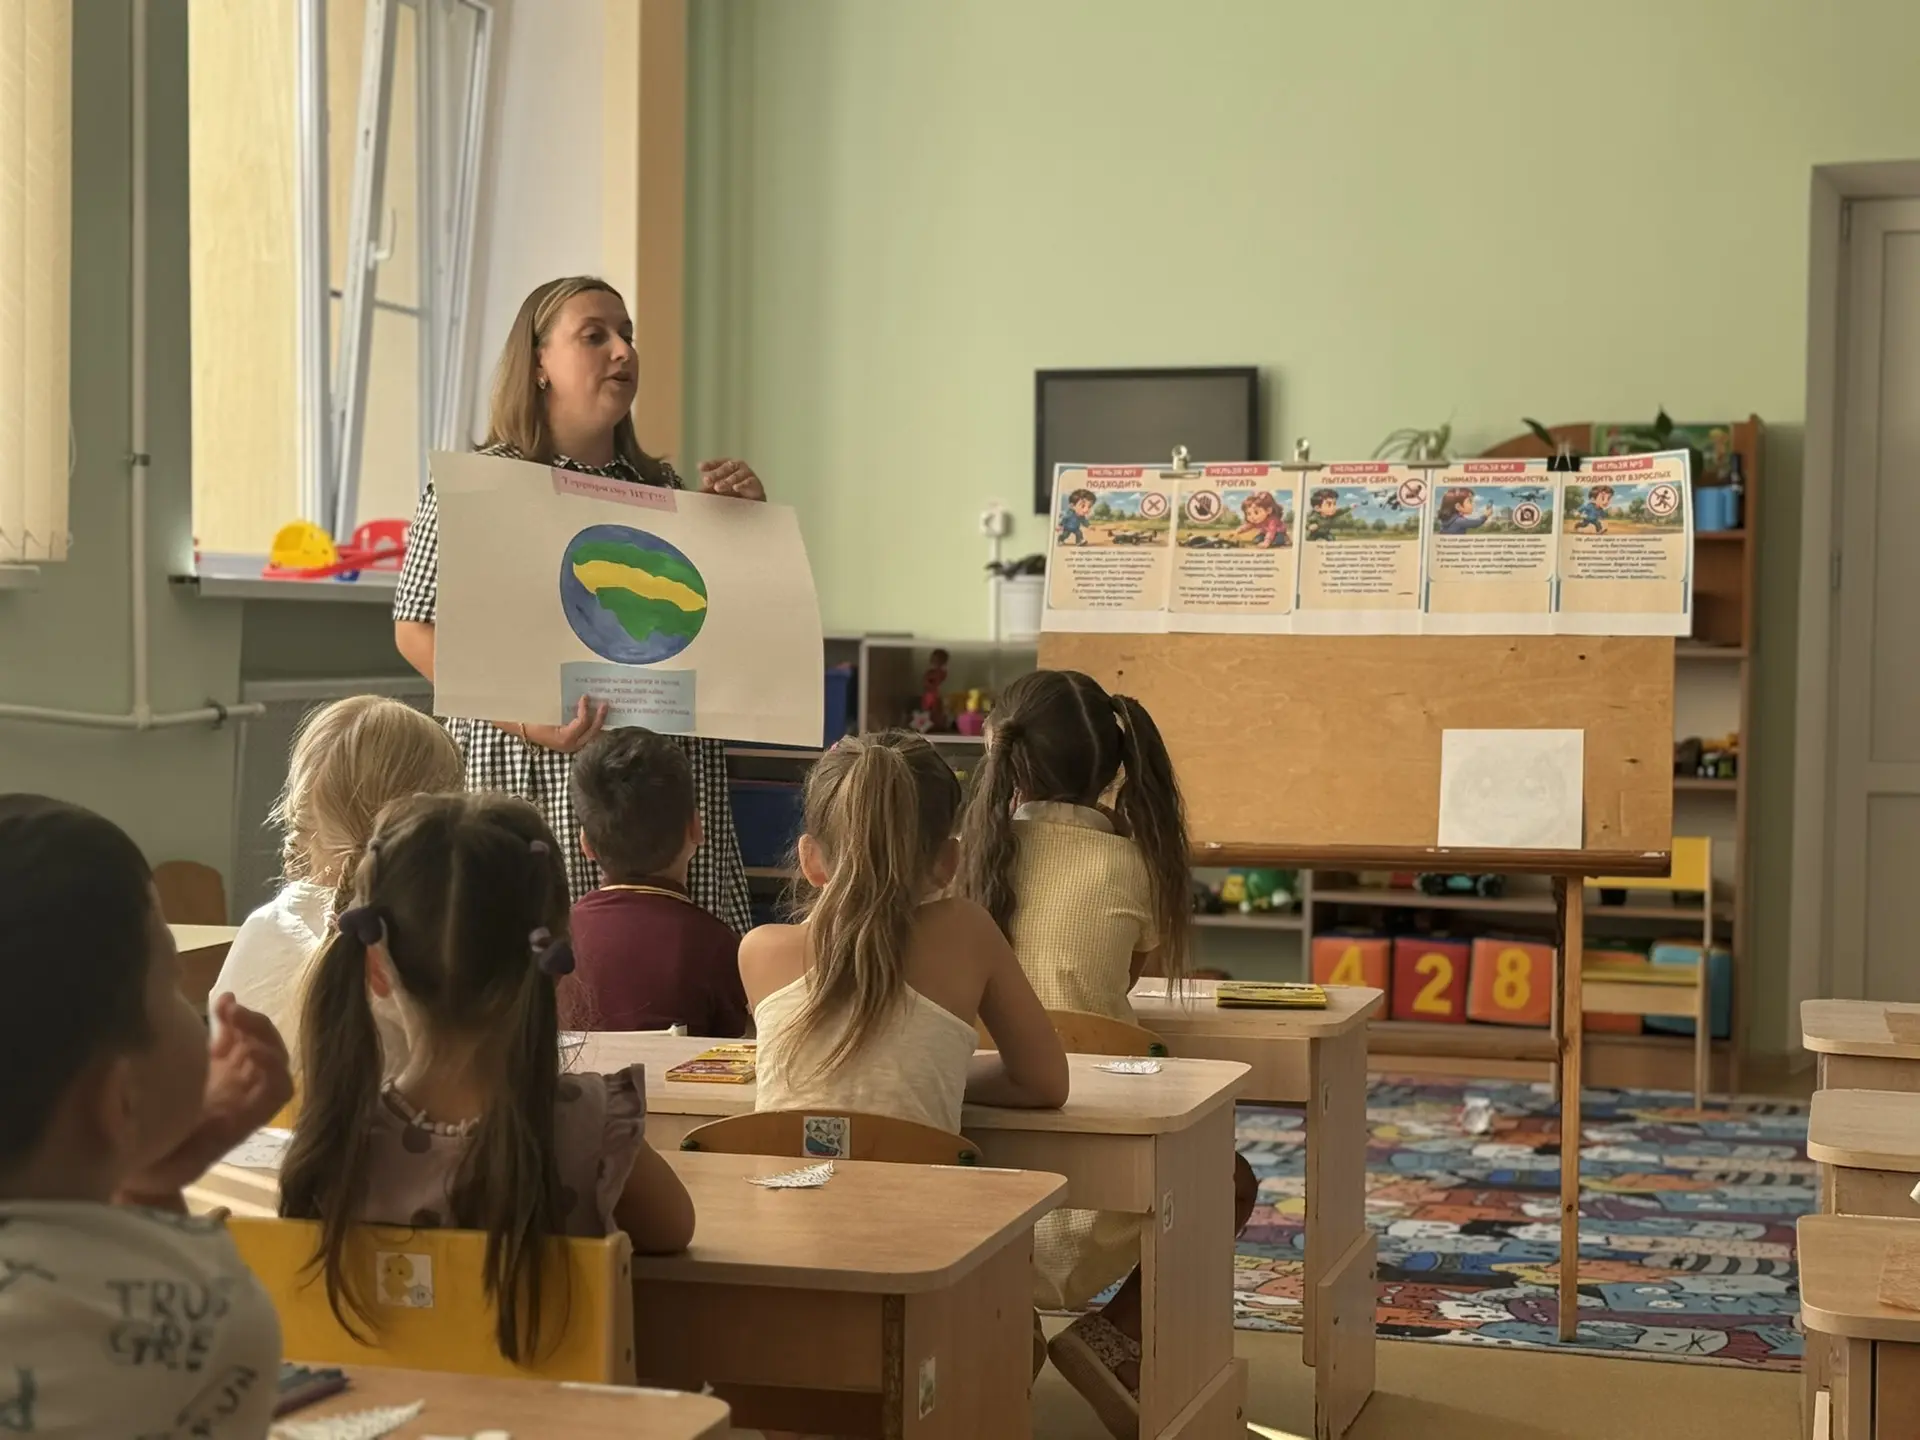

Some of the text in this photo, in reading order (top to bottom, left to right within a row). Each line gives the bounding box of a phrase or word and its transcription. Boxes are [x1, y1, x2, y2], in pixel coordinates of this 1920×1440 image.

[1467, 464, 1499, 472] НЕЛЬЗЯ
[1597, 461, 1628, 470] НЕЛЬЗЯ
[1092, 469, 1123, 477] НЕЛЬЗЯ
[1575, 471, 1672, 484] УХОДИТЬ ОТ ВЗРОСЛЫХ
[1215, 479, 1257, 488] ТРОГАТЬ
[1321, 475, 1398, 484] ПЫТАТЬСЯ СБИТЬ
[1442, 476, 1478, 484] СНИМАТЬ
[1491, 475, 1550, 483] ЛЮБОПЫТСТВА
[1086, 480, 1143, 489] ПОДХОДИТЬ
[1329, 945, 1367, 986] 4
[1492, 947, 1532, 1010] 8
[1412, 952, 1453, 1015] 2
